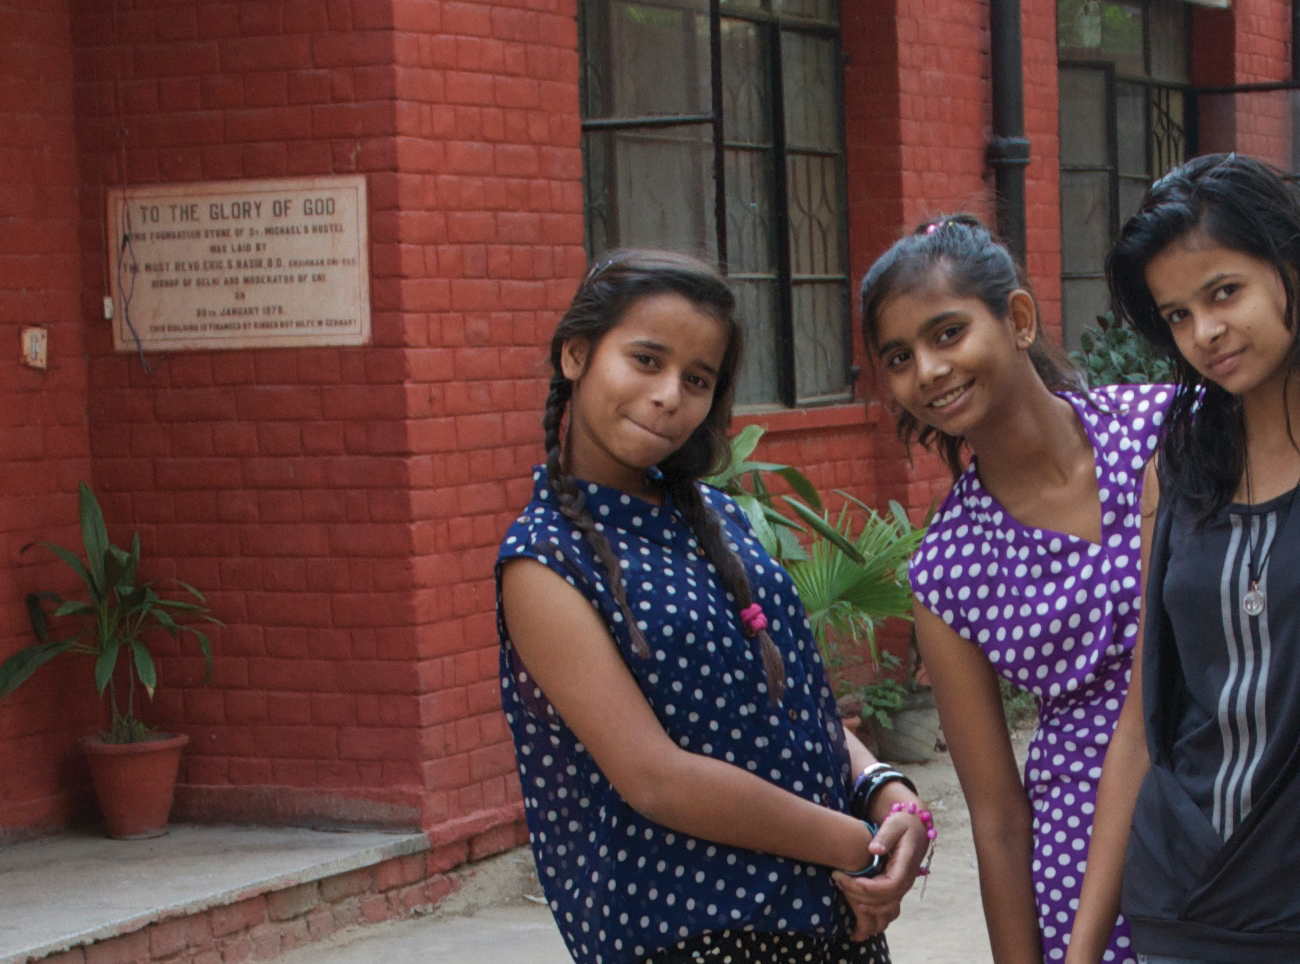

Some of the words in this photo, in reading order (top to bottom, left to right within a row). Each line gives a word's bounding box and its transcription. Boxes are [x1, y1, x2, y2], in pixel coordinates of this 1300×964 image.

[139, 206, 159, 223] TO
[169, 204, 199, 222] THE
[209, 201, 262, 220] GLORY
[272, 199, 293, 217] OF
[303, 197, 336, 216] GOD
[150, 230, 200, 240] FOUNDATION
[203, 229, 230, 239] STONE
[234, 227, 244, 237] OF
[209, 244, 227, 253] WAS
[231, 243, 251, 253] LAID
[255, 242, 267, 252] BY
[145, 262, 170, 272] MOST
[151, 279, 180, 289] BISHOP
[183, 278, 192, 288] OF
[196, 277, 220, 287] DELHI
[224, 276, 239, 286] AND
[243, 274, 294, 285] MODERATOR
[298, 273, 308, 283] OF
[220, 306, 259, 316] JANUARY
